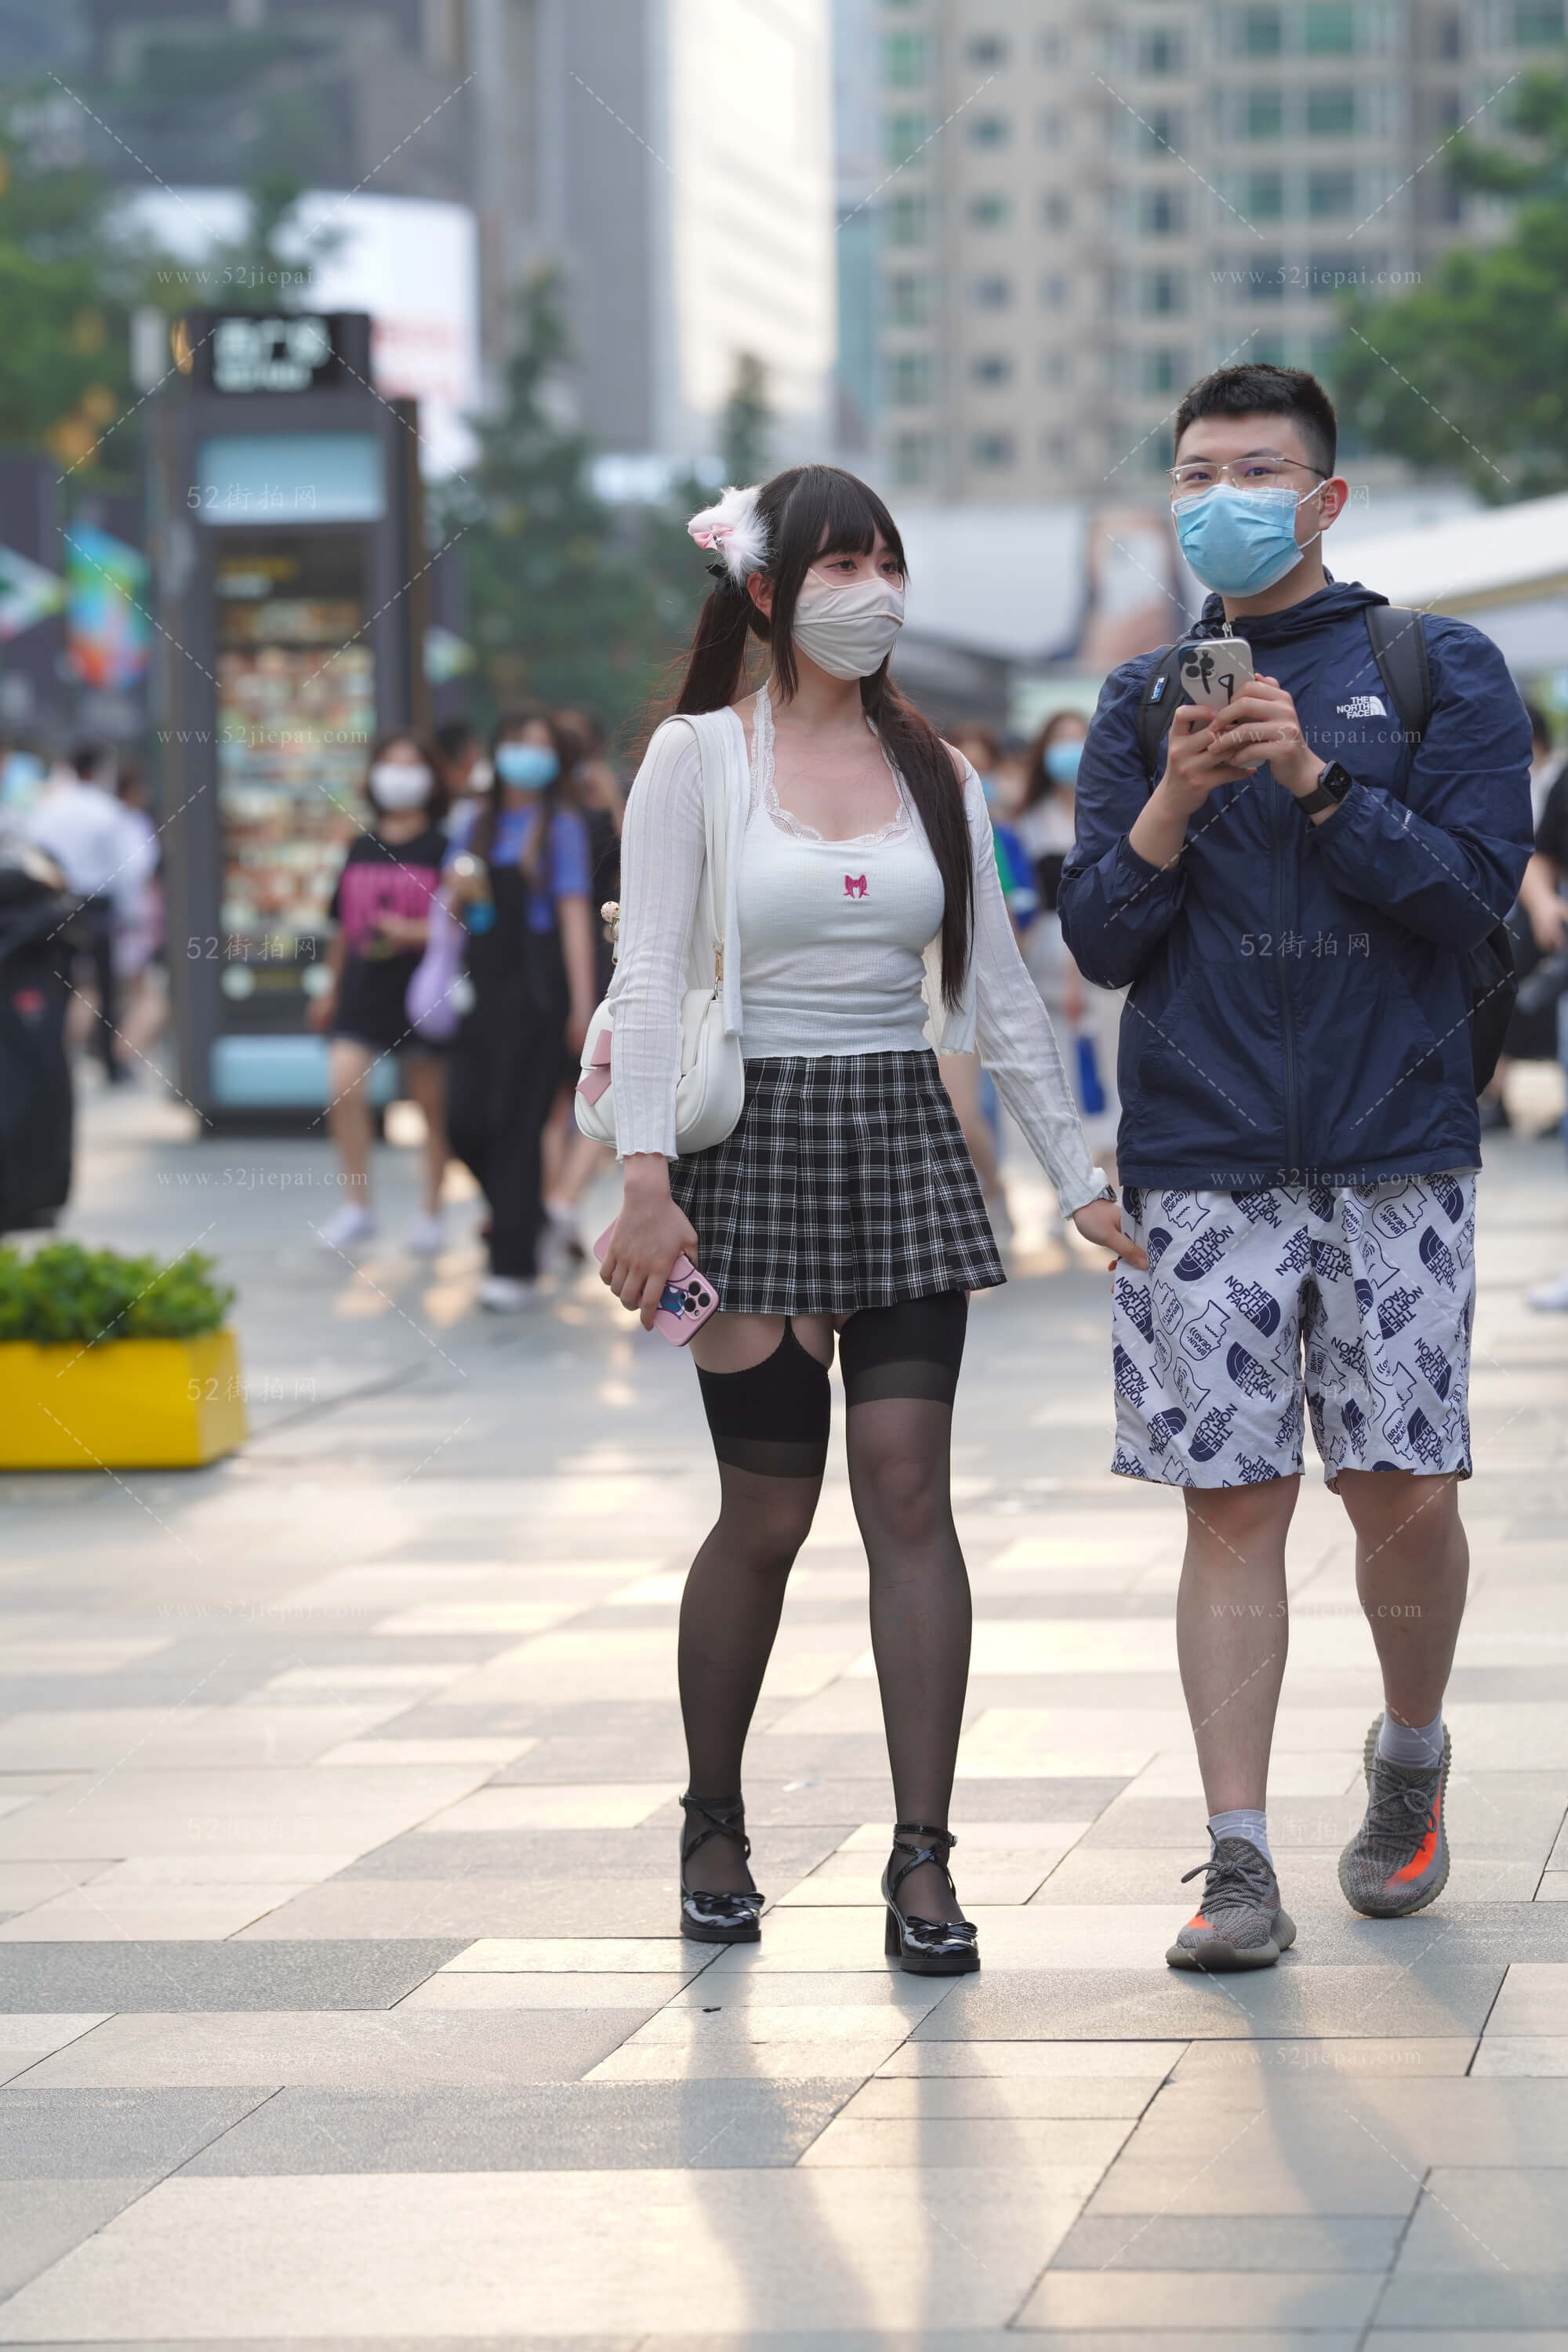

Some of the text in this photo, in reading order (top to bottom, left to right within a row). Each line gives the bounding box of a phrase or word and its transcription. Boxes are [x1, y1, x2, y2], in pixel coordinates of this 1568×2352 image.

[1336, 702, 1370, 714] NORTH
[1347, 710, 1370, 719] FACE
[1238, 1203, 1259, 1224] THE
[1187, 1227, 1216, 1254] FACE
[1195, 1225, 1235, 1267] NORTH
[1283, 1228, 1305, 1251] THE
[1202, 1249, 1226, 1272] THE
[1316, 1264, 1338, 1283] THE
[1319, 1256, 1354, 1277] ORTH
[1426, 1261, 1446, 1286] THE
[1116, 1276, 1152, 1318] NORTH
[1225, 1275, 1265, 1312] NORTH
[1226, 1291, 1257, 1319] FACE
[1250, 1281, 1272, 1304] THE
[1377, 1287, 1407, 1316] FACE
[1383, 1286, 1425, 1325] NORTH
[1115, 1293, 1142, 1323] FACE
[1391, 1311, 1417, 1333] THE
[1195, 1333, 1212, 1352] DEAD
[1434, 1345, 1448, 1367] THE
[1414, 1337, 1444, 1377] NORTH
[1415, 1356, 1438, 1385] FACE
[1127, 1363, 1149, 1393] FACE
[1240, 1366, 1277, 1403] NORTH
[1247, 1358, 1276, 1386] FACE
[1116, 1370, 1145, 1409] NORTH
[1236, 1379, 1254, 1399] THE
[1195, 1406, 1221, 1438] FACE
[1201, 1403, 1239, 1446] NORTH
[1211, 1428, 1234, 1453] THE
[1254, 1455, 1276, 1475] THE
